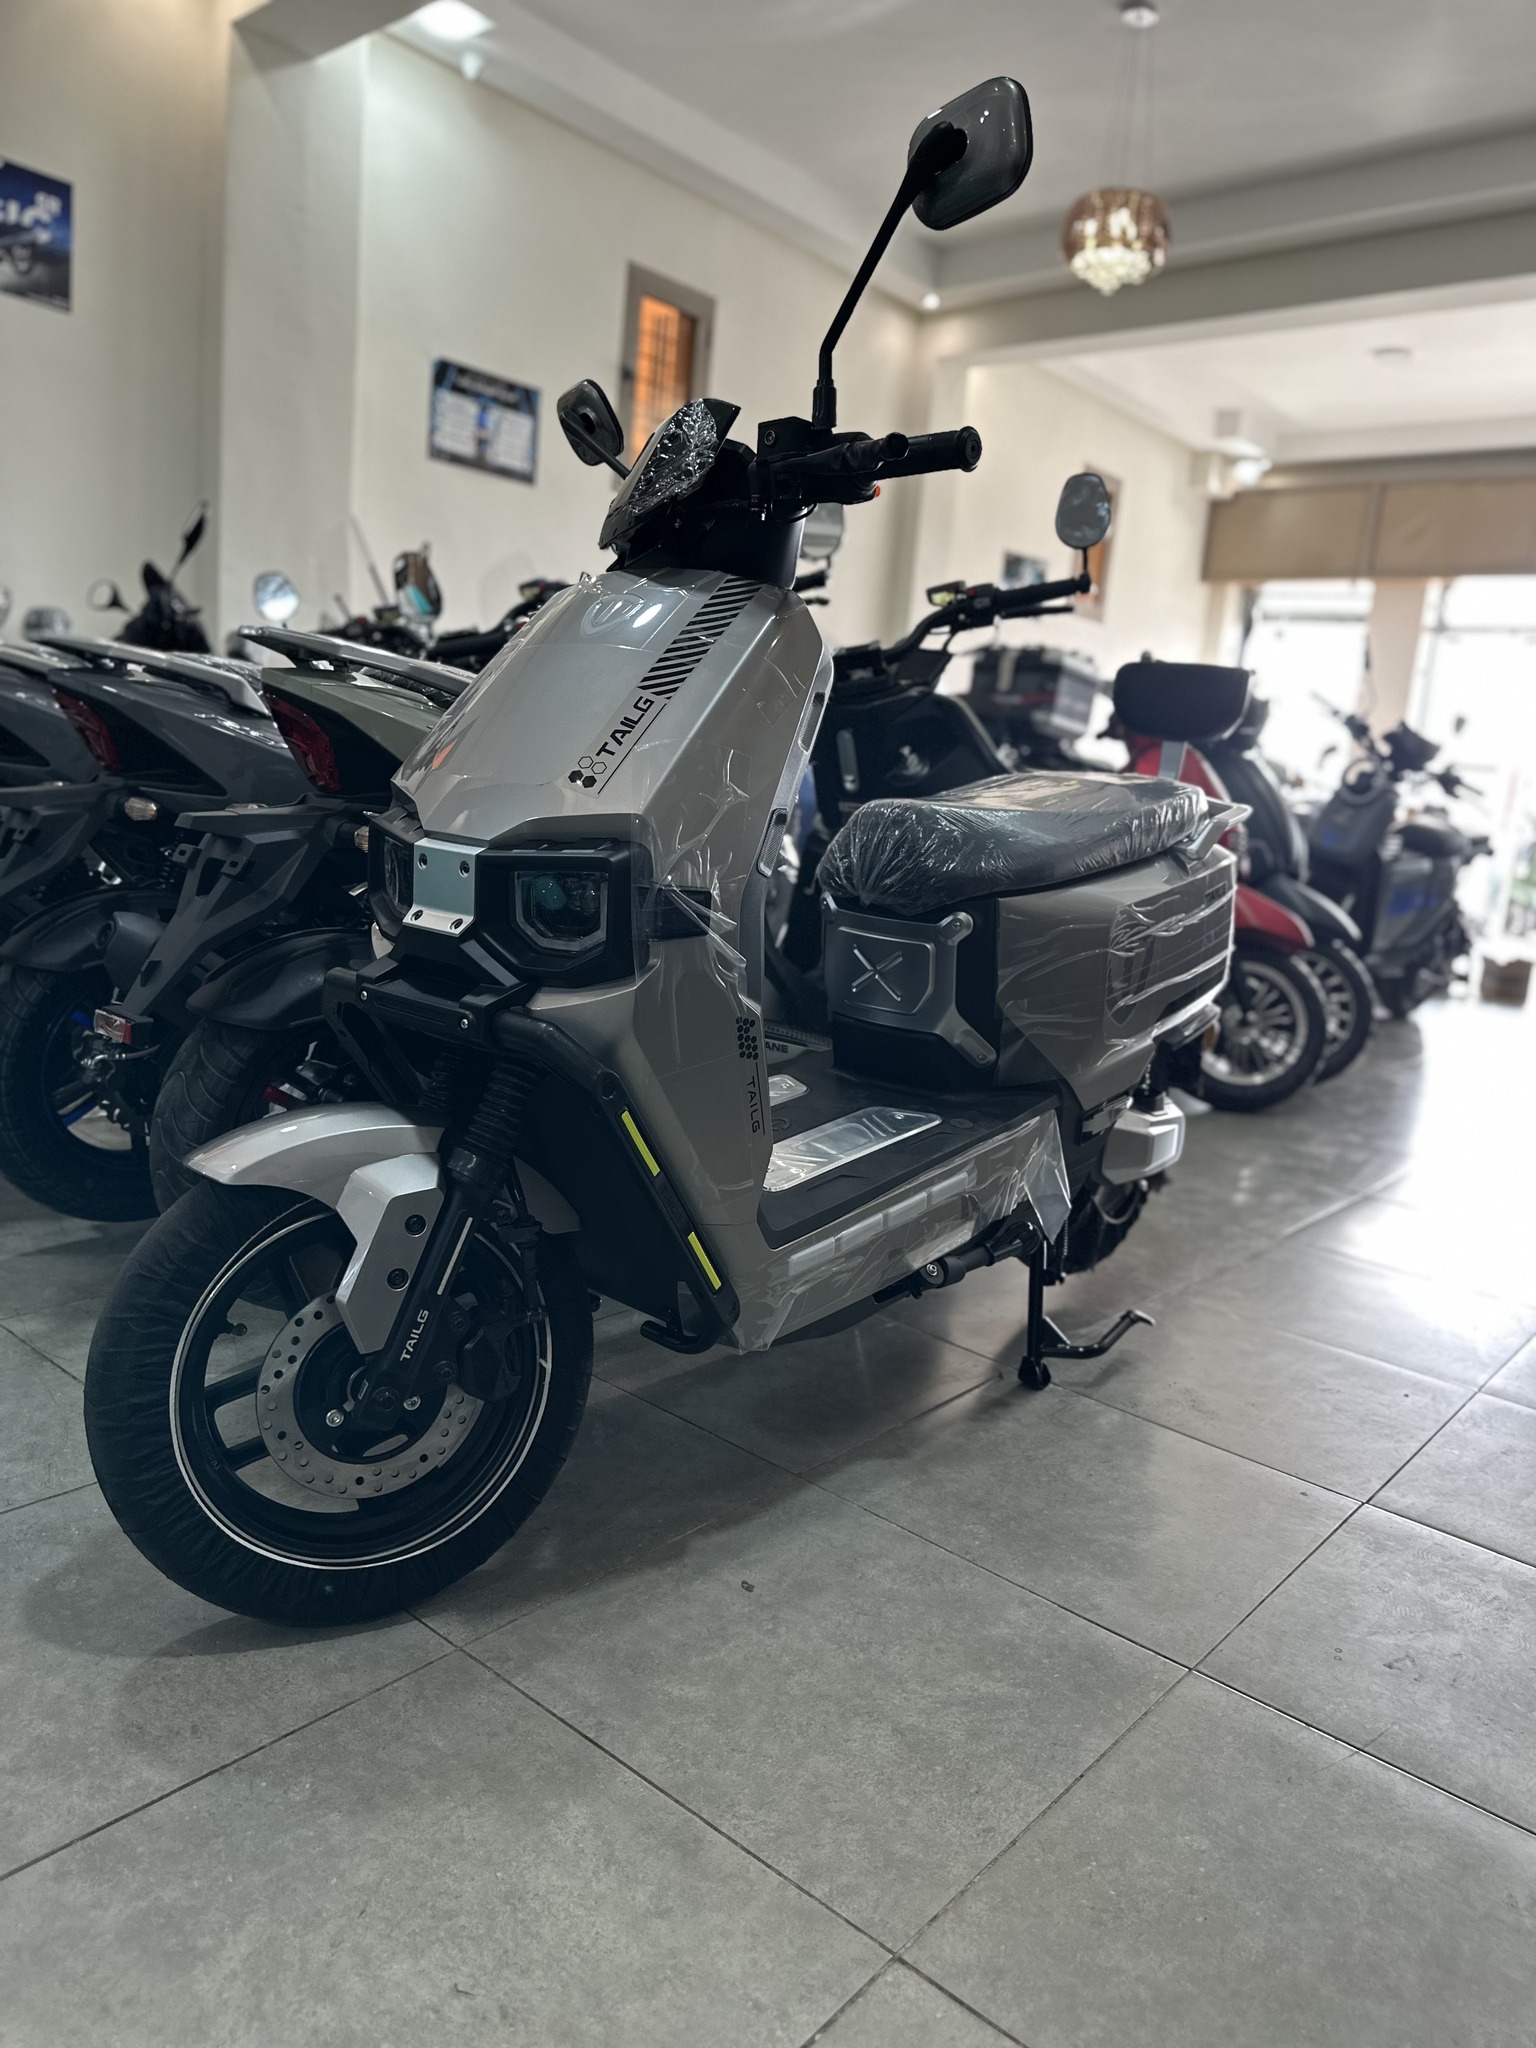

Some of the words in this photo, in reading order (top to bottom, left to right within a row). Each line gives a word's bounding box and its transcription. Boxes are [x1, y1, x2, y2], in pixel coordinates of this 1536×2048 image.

[595, 695, 655, 757] TAILG
[746, 1075, 760, 1133] TAILG
[399, 1309, 429, 1362] TAILG
